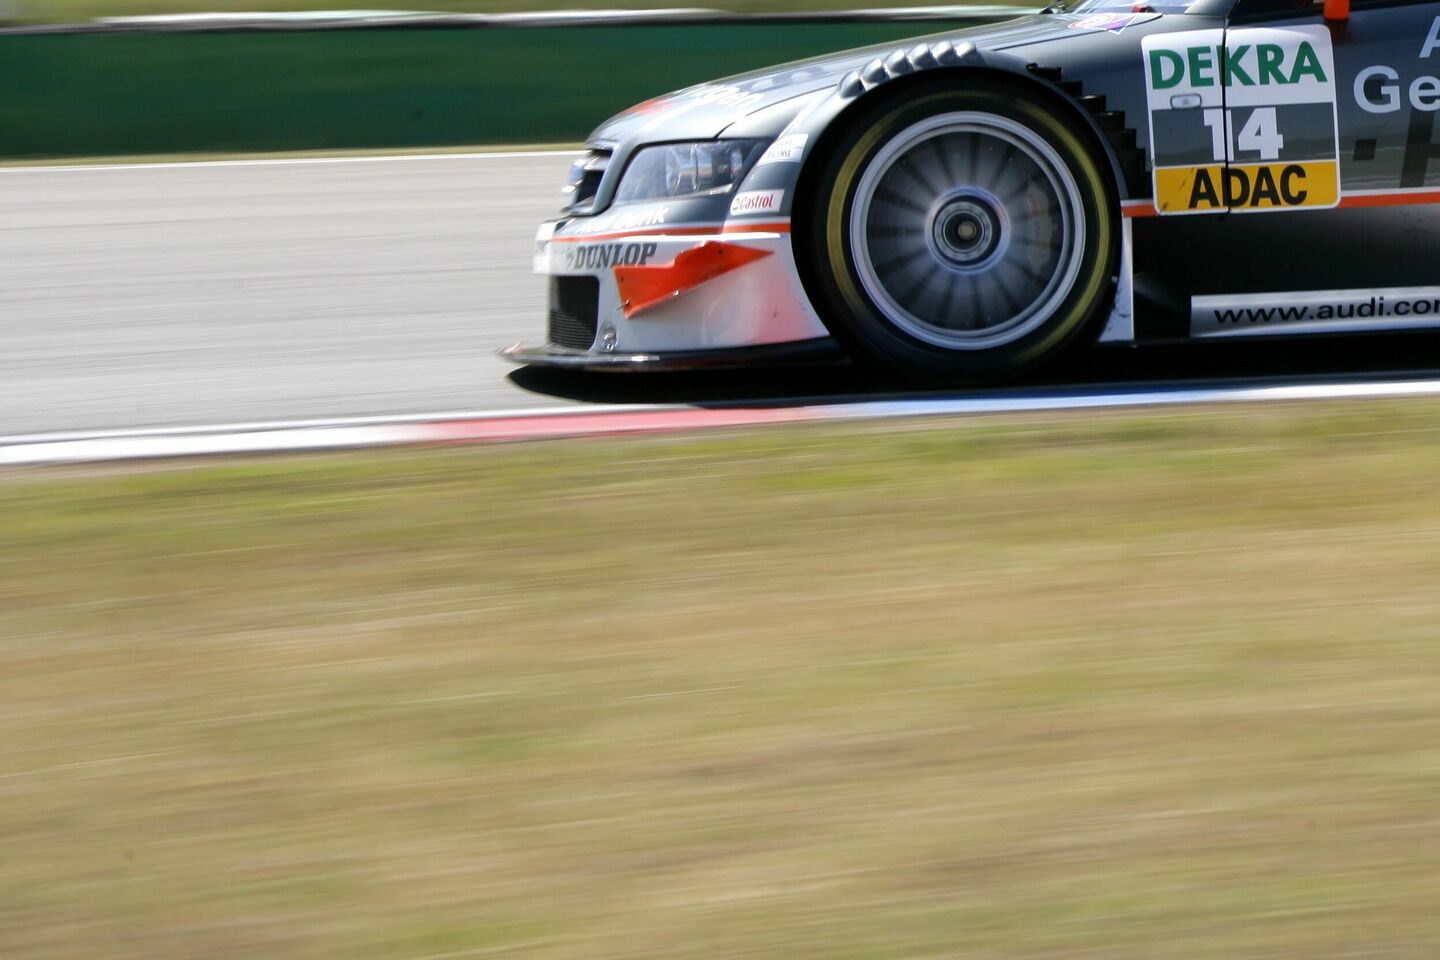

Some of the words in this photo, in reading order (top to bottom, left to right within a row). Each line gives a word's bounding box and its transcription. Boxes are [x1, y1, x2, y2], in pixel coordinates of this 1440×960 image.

[1148, 40, 1328, 90] DEKRA
[1203, 106, 1284, 162] 14
[740, 193, 774, 210] Castrol
[1188, 164, 1308, 209] ADAC
[574, 242, 658, 269] DUNLOP
